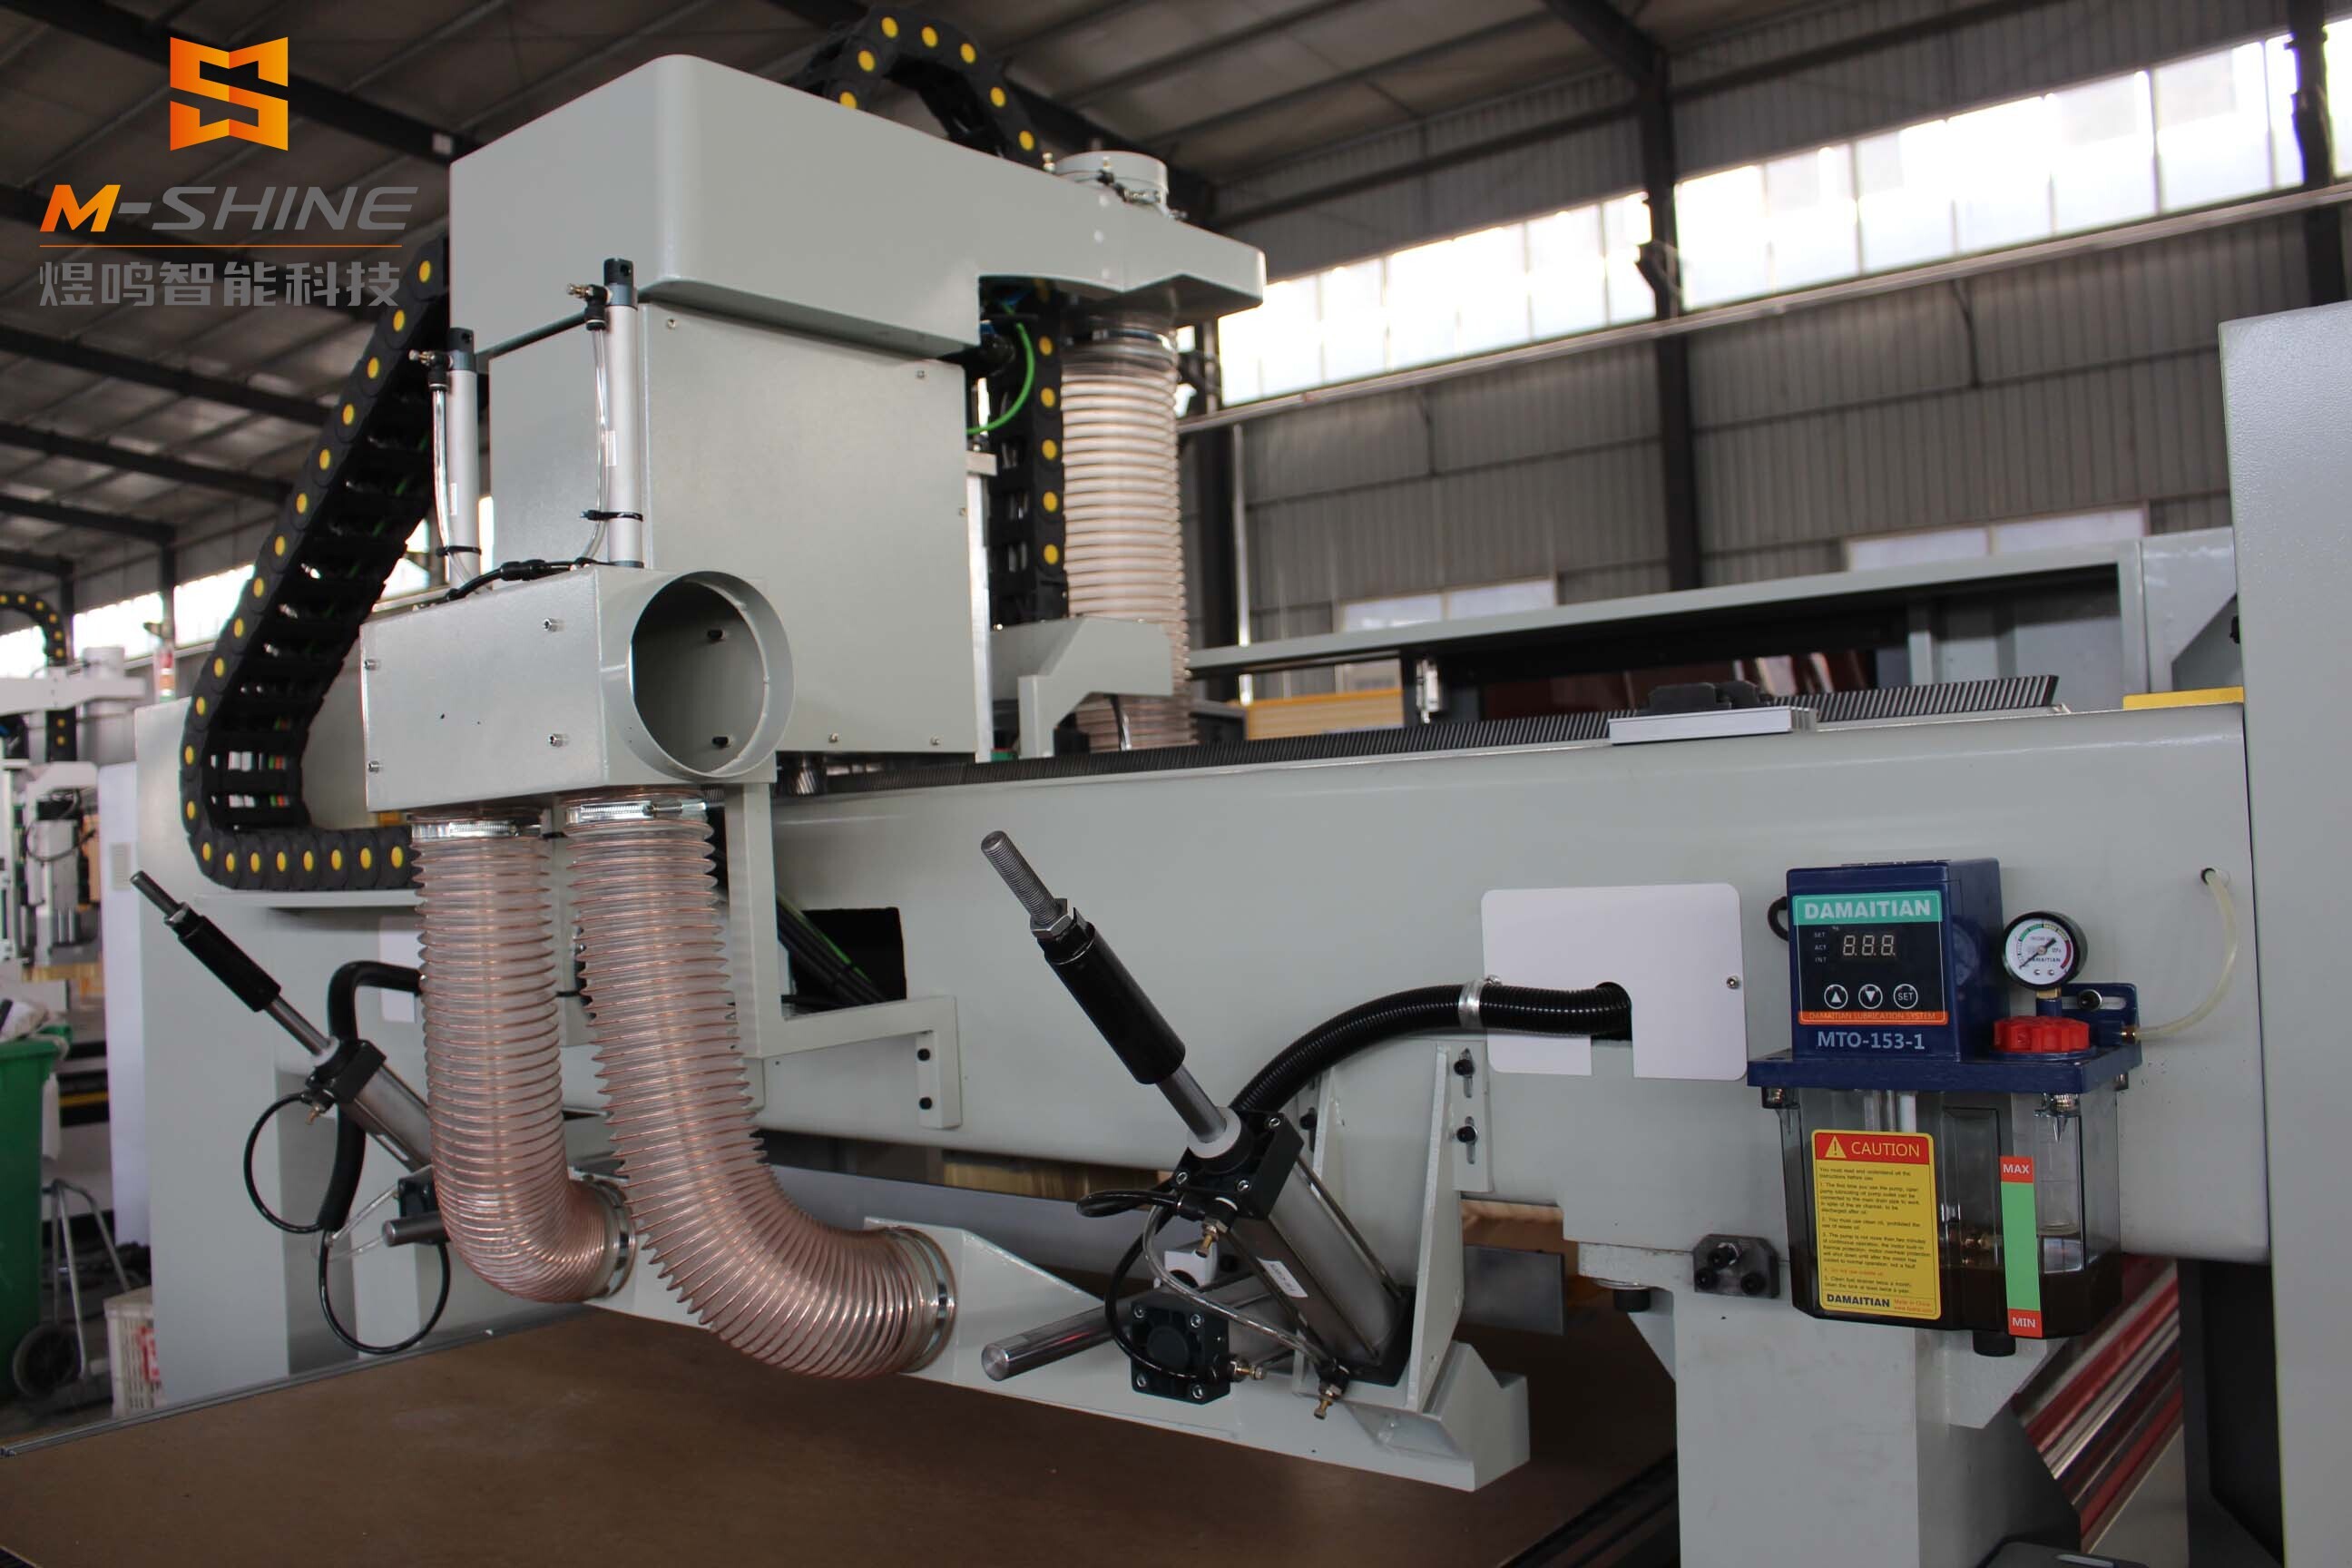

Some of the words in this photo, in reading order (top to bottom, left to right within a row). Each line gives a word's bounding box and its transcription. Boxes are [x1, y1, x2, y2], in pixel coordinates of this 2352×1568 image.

[1804, 899, 1931, 919] DAMAITIAN
[1897, 992, 1914, 1002] SET
[1818, 1031, 1926, 1050] MTO-153-1
[1851, 1141, 1920, 1158] CAUTION
[2003, 1163, 2030, 1175] MAX
[1827, 1293, 1890, 1308] DAMAITIAN
[2012, 1317, 2036, 1328] MIN
